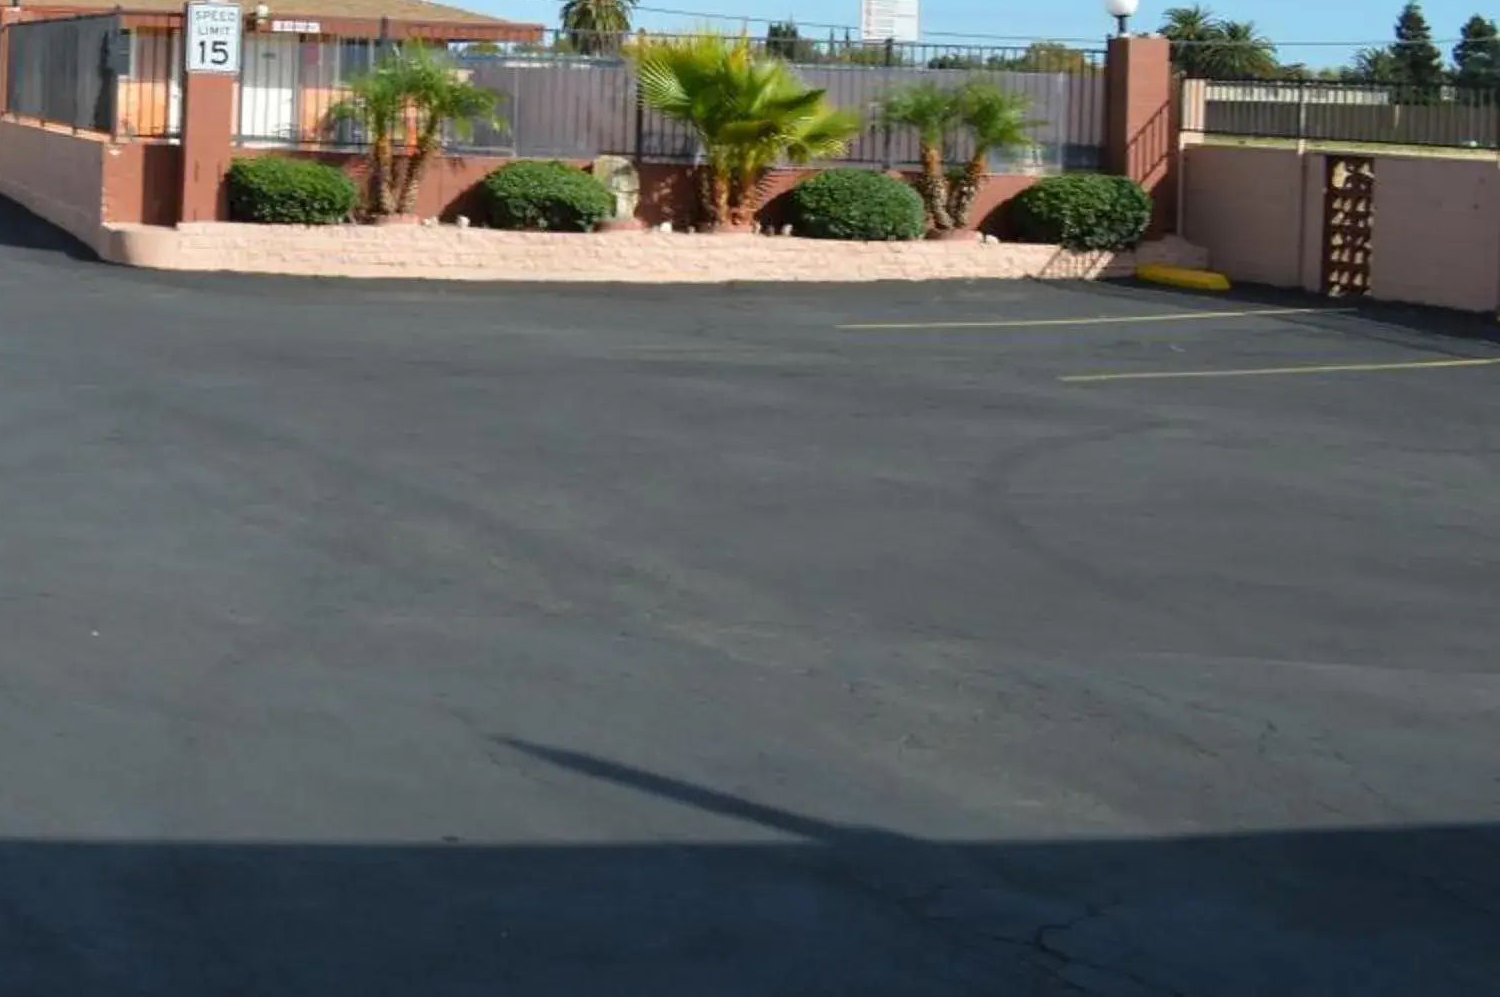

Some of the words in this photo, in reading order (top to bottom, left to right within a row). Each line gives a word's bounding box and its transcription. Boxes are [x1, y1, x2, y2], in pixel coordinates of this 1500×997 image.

[195, 10, 236, 22] SPEED
[198, 26, 230, 36] LIMIT
[199, 40, 229, 65] 15
